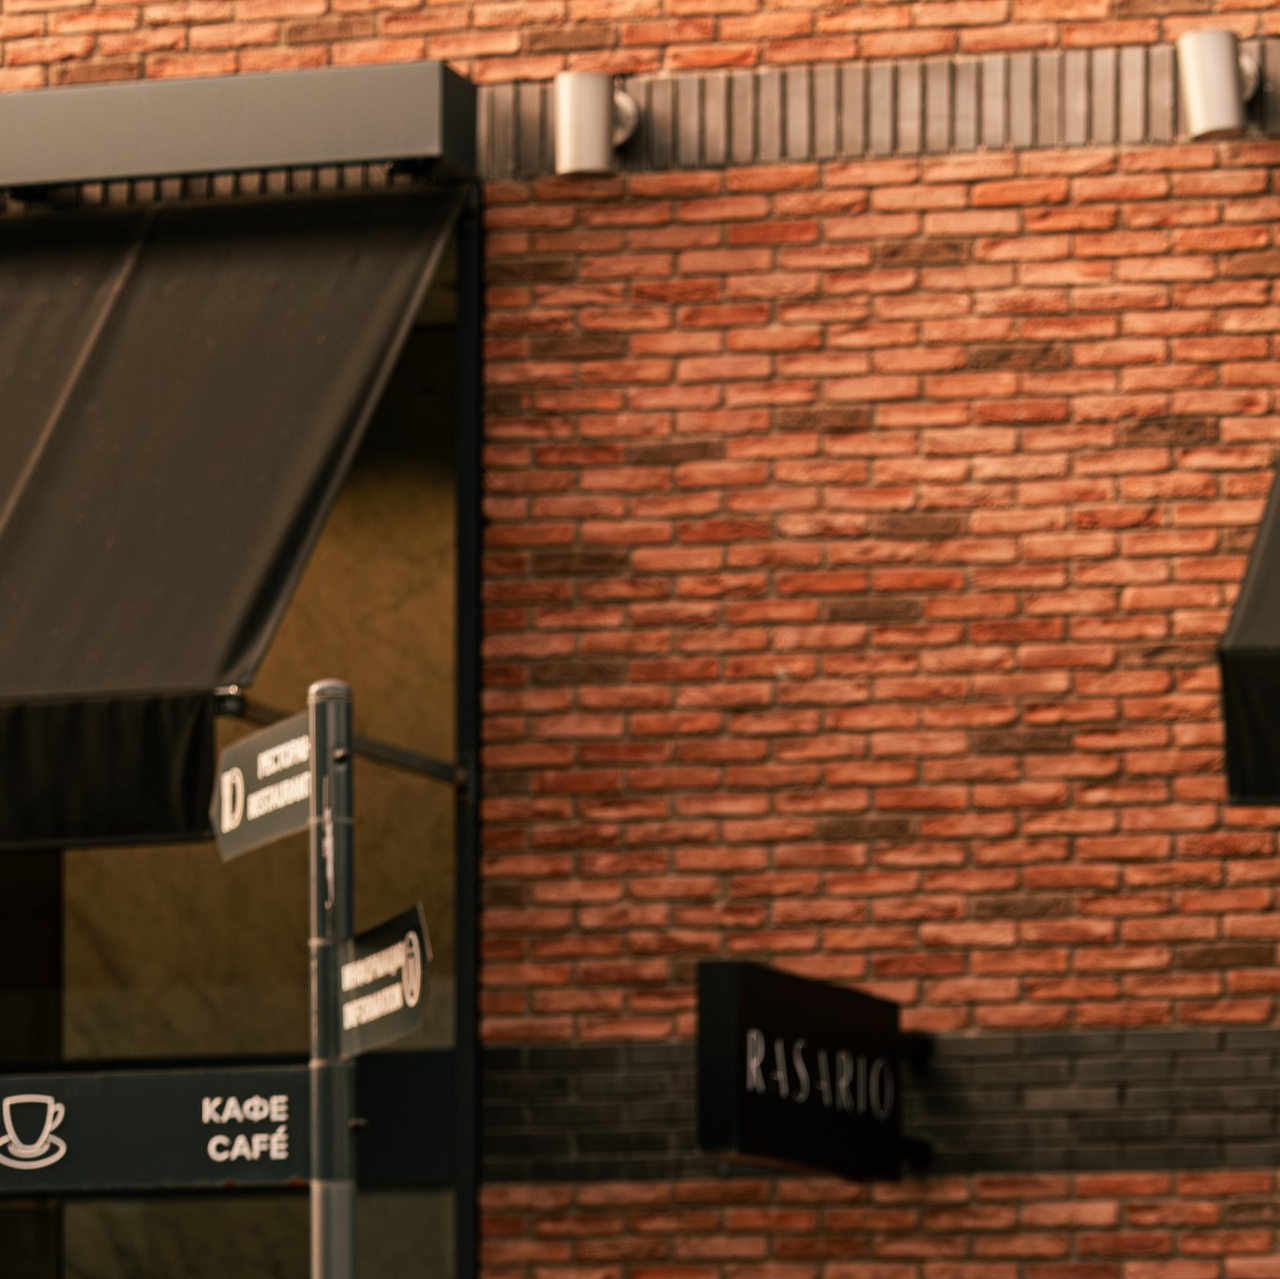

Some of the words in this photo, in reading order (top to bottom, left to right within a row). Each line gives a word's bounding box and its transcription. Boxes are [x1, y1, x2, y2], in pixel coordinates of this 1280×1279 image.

[745, 1027, 895, 1121] RASARIO
[201, 1094, 289, 1124] КАФЕ
[206, 1125, 289, 1162] CAFÉ
